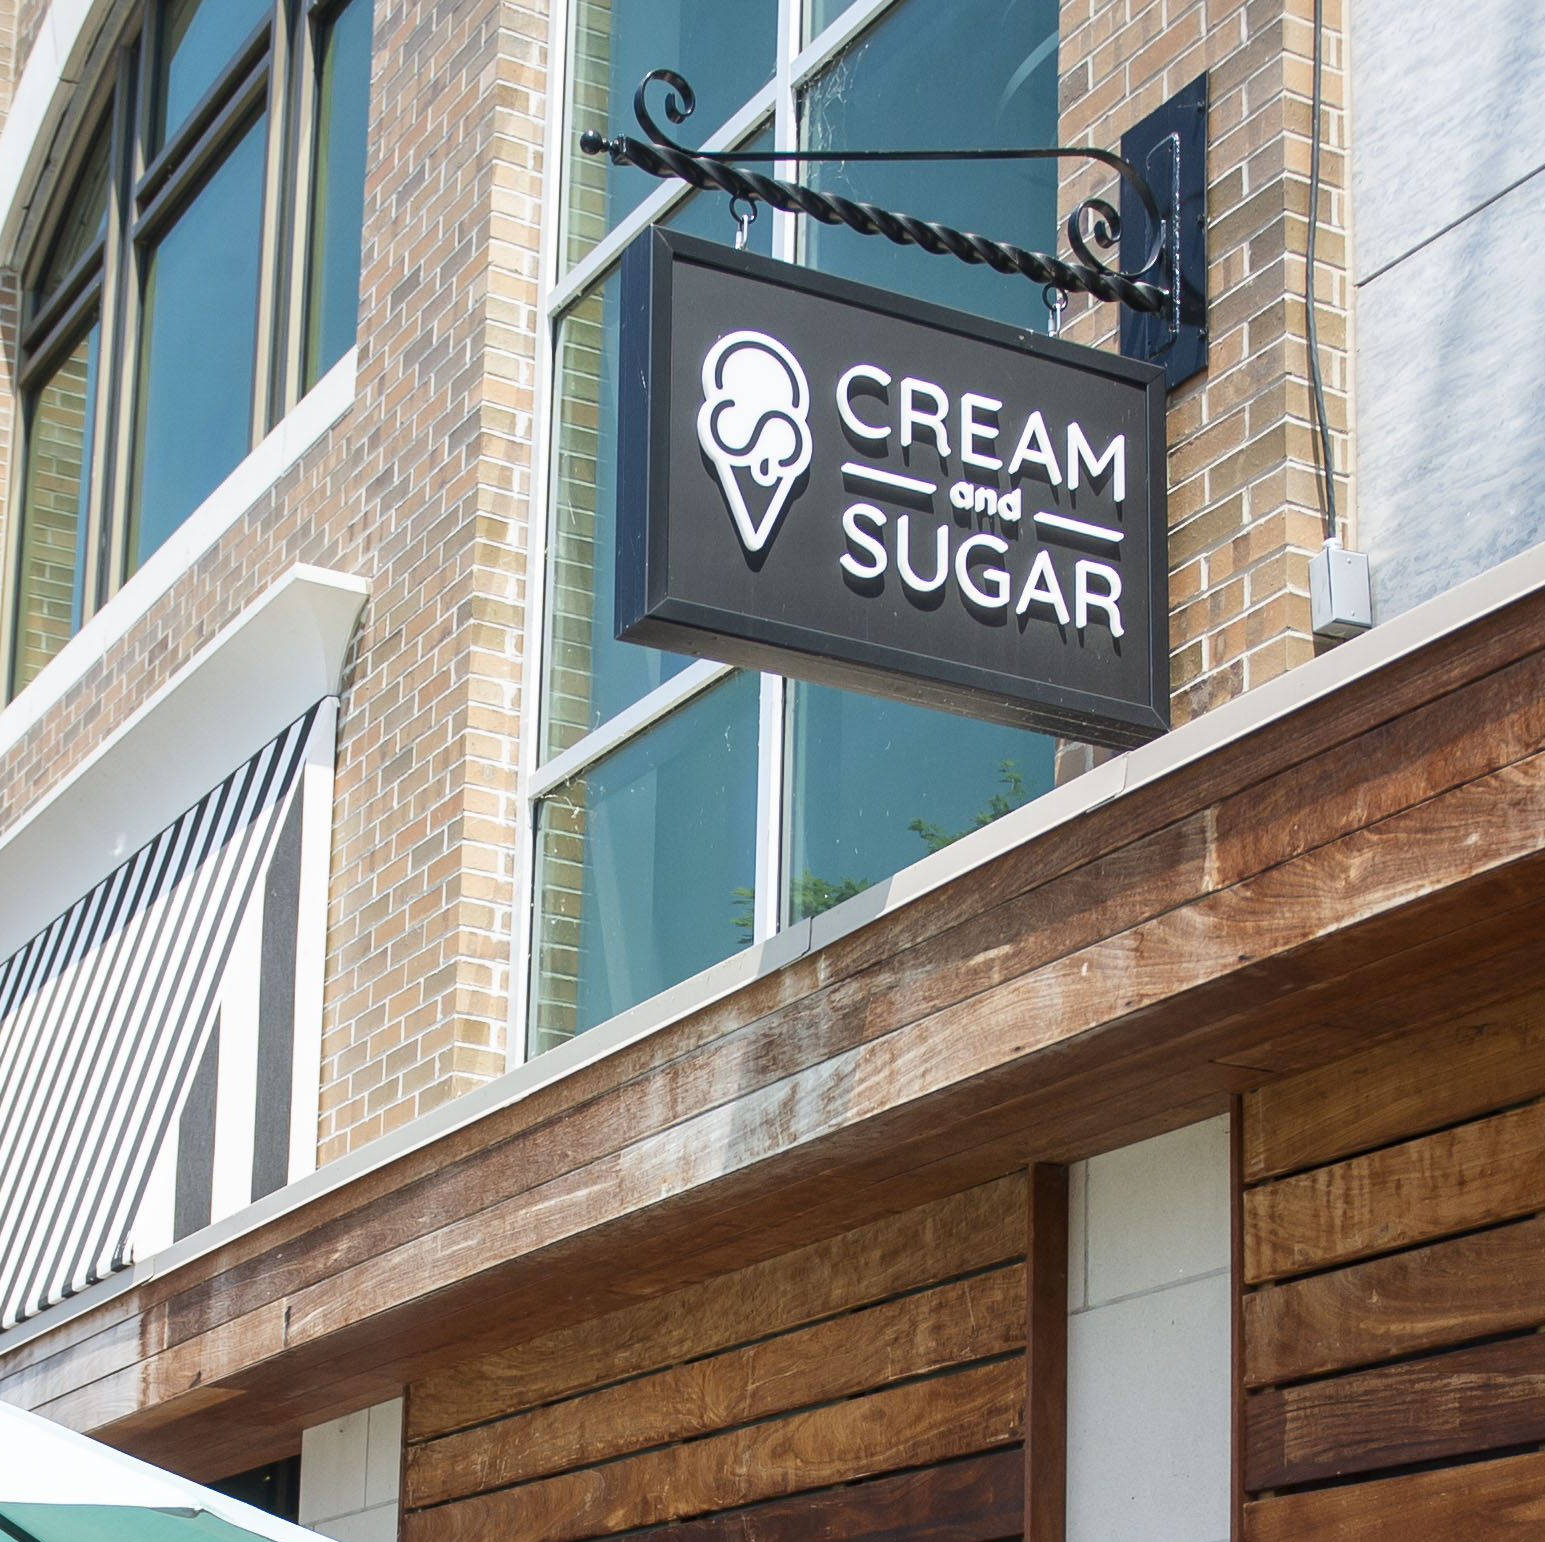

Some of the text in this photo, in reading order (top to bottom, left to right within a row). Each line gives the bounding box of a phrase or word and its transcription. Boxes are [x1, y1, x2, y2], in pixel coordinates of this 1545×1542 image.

[835, 364, 1126, 503] CREAM
[949, 481, 1022, 522] and
[839, 502, 1125, 638] SUGAR
